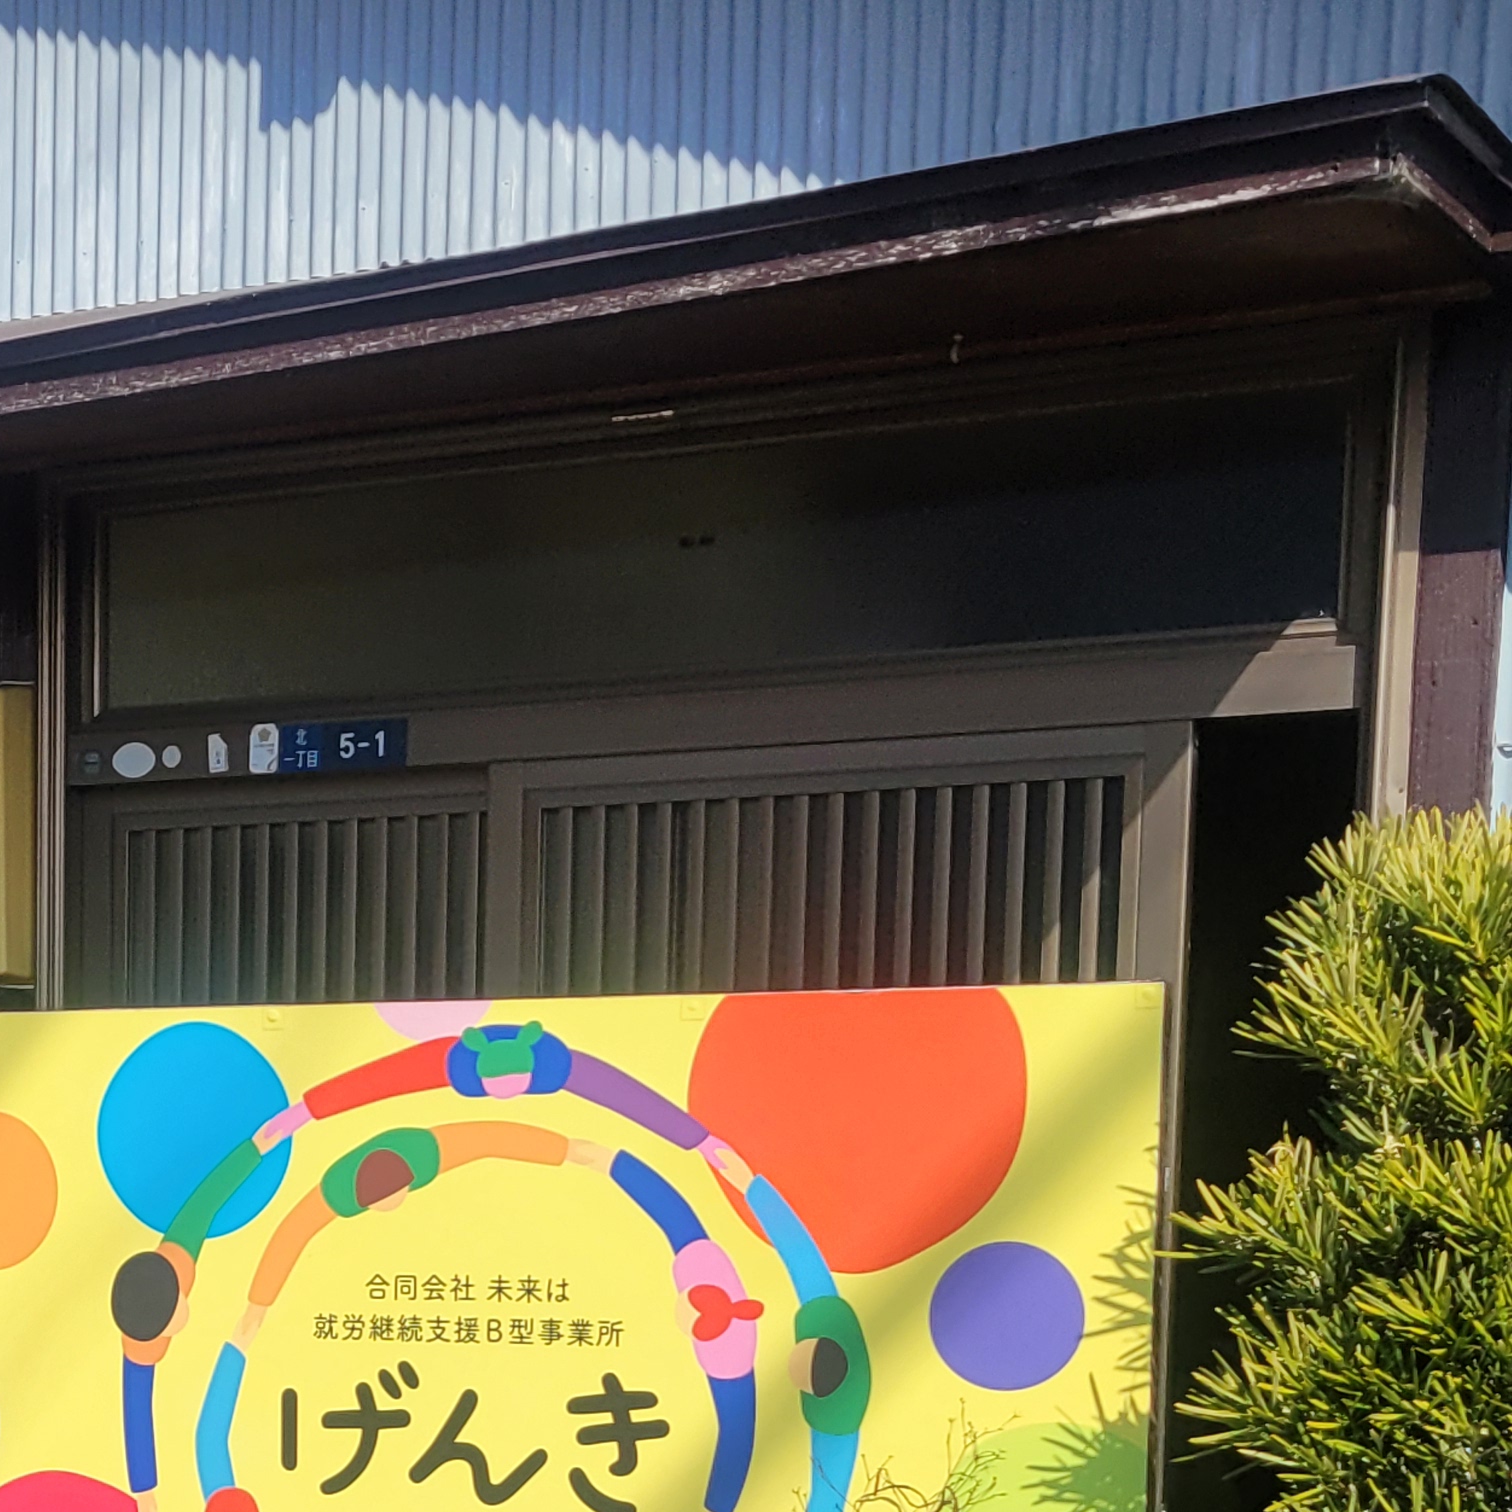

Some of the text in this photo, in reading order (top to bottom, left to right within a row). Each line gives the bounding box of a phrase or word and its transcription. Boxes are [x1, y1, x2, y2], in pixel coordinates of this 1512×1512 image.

[339, 729, 385, 759] 5-1
[283, 750, 319, 769] 一丁目
[365, 1273, 570, 1303] 合同会社 未来は
[312, 1313, 625, 1348] 就労継続支援B型事業所
